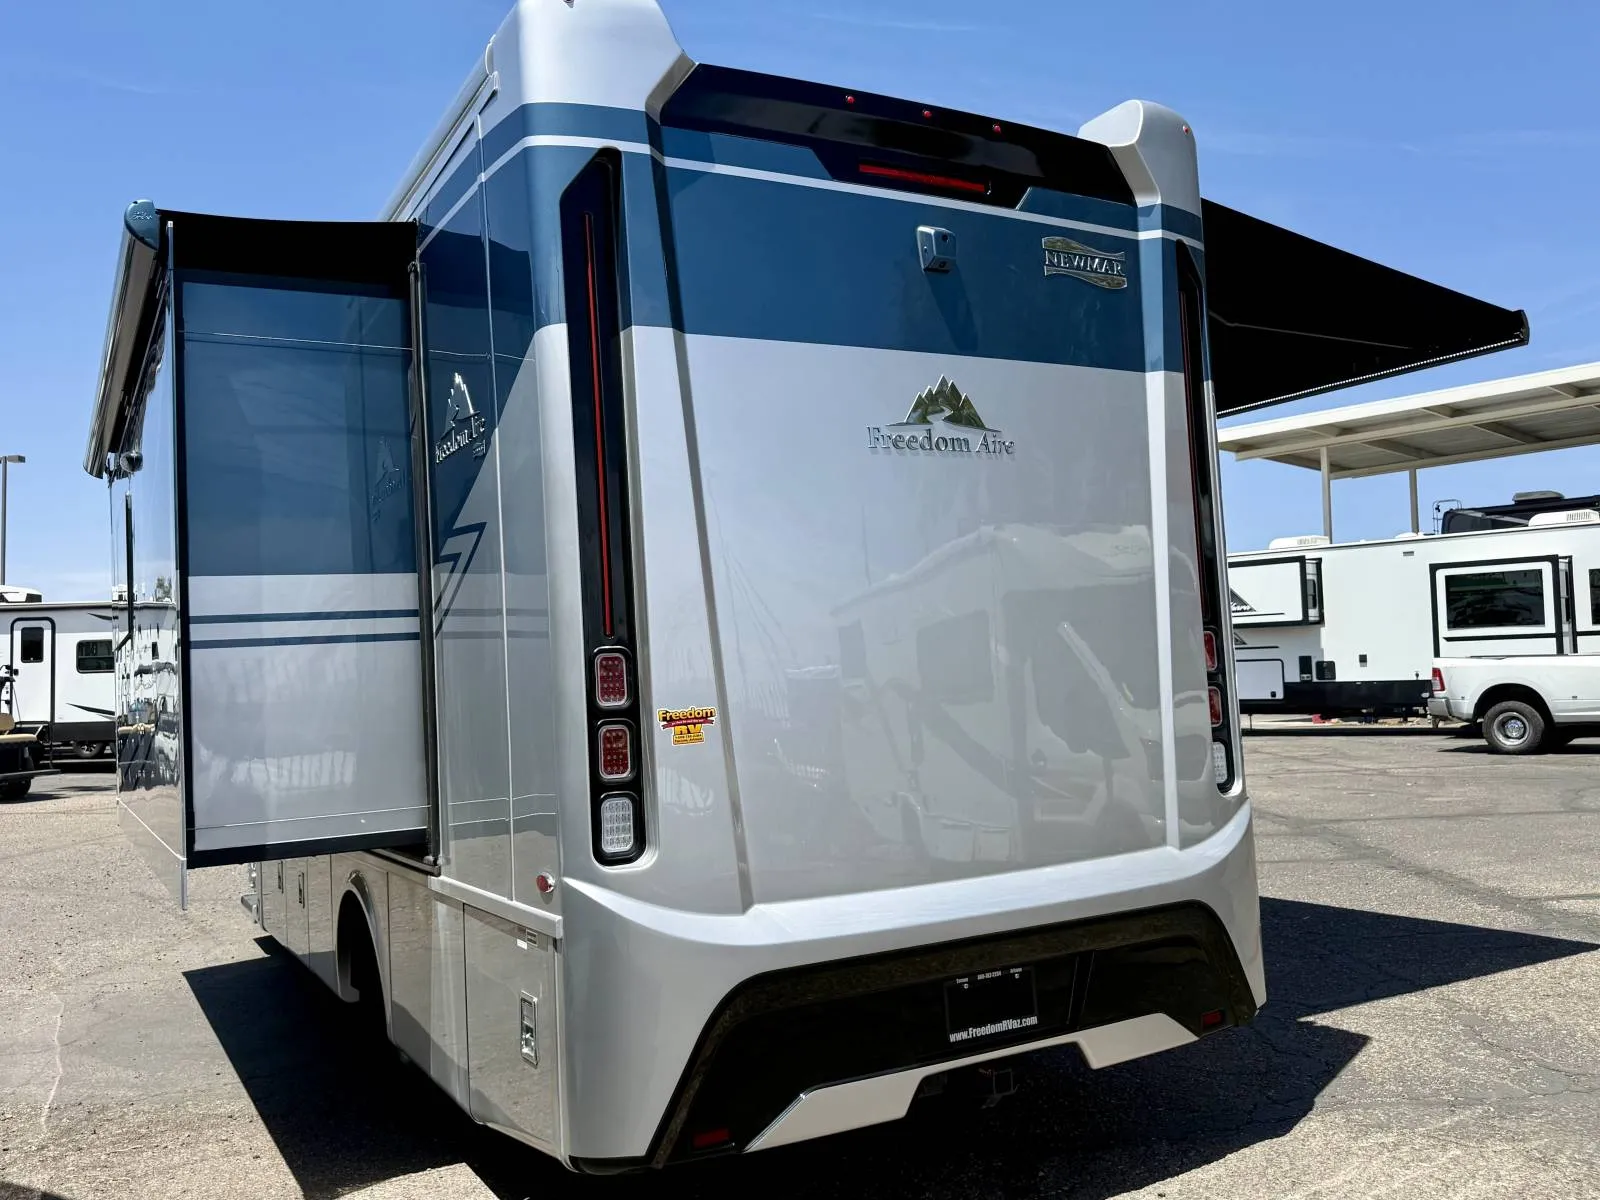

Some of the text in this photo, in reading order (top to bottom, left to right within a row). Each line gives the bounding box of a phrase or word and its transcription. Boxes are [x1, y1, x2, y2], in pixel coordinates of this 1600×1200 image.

[1045, 250, 1125, 275] NEWMAR
[866, 425, 1016, 455] Freedom Aire
[658, 706, 716, 721] Freedom
[674, 723, 702, 735] RV
[949, 1016, 1038, 1043] www.FreedomRVaz.com
